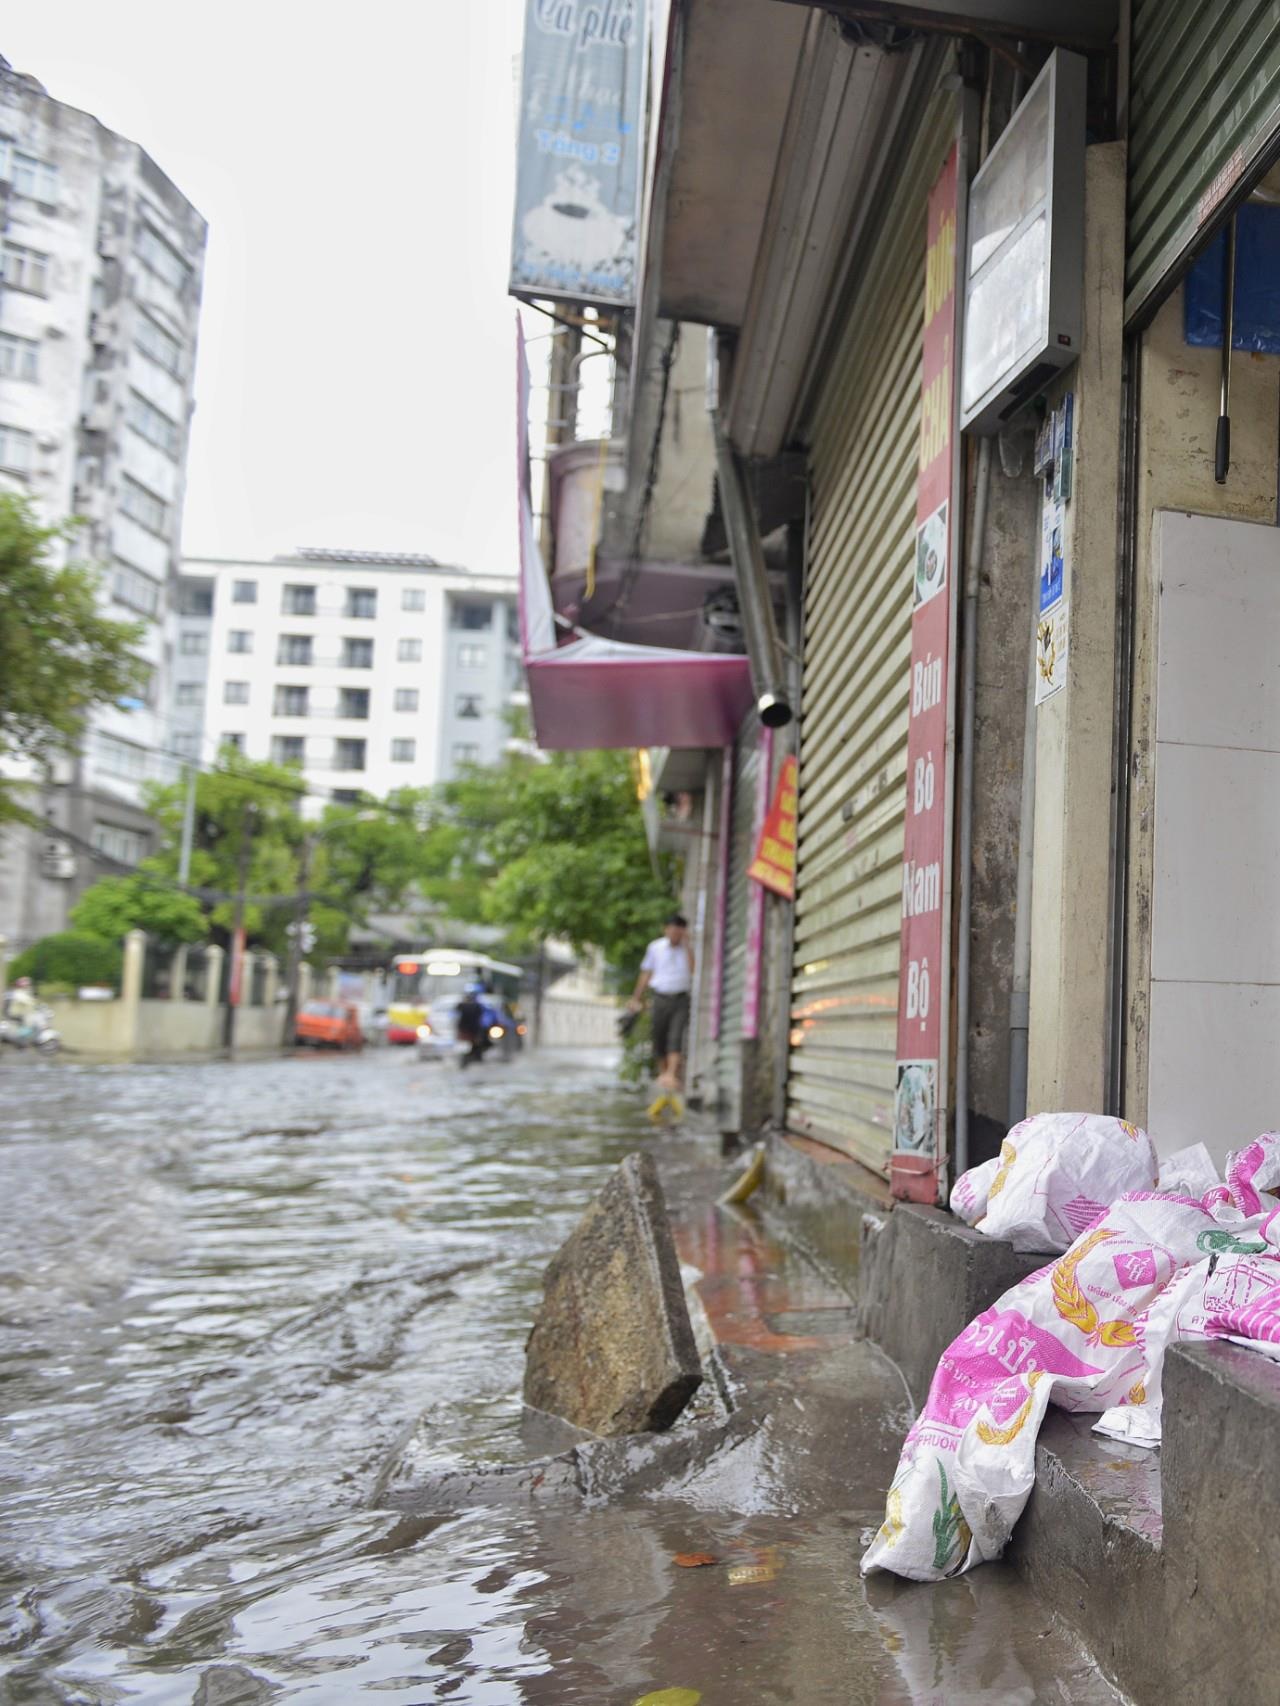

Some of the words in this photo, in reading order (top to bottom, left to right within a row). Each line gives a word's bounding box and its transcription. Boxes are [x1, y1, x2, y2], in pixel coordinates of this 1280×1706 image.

[924, 208, 956, 328] BÚN
[912, 652, 942, 718] Bún
[914, 751, 935, 815] Bò
[902, 860, 940, 918] Nam
[906, 957, 930, 1032] Bộ
